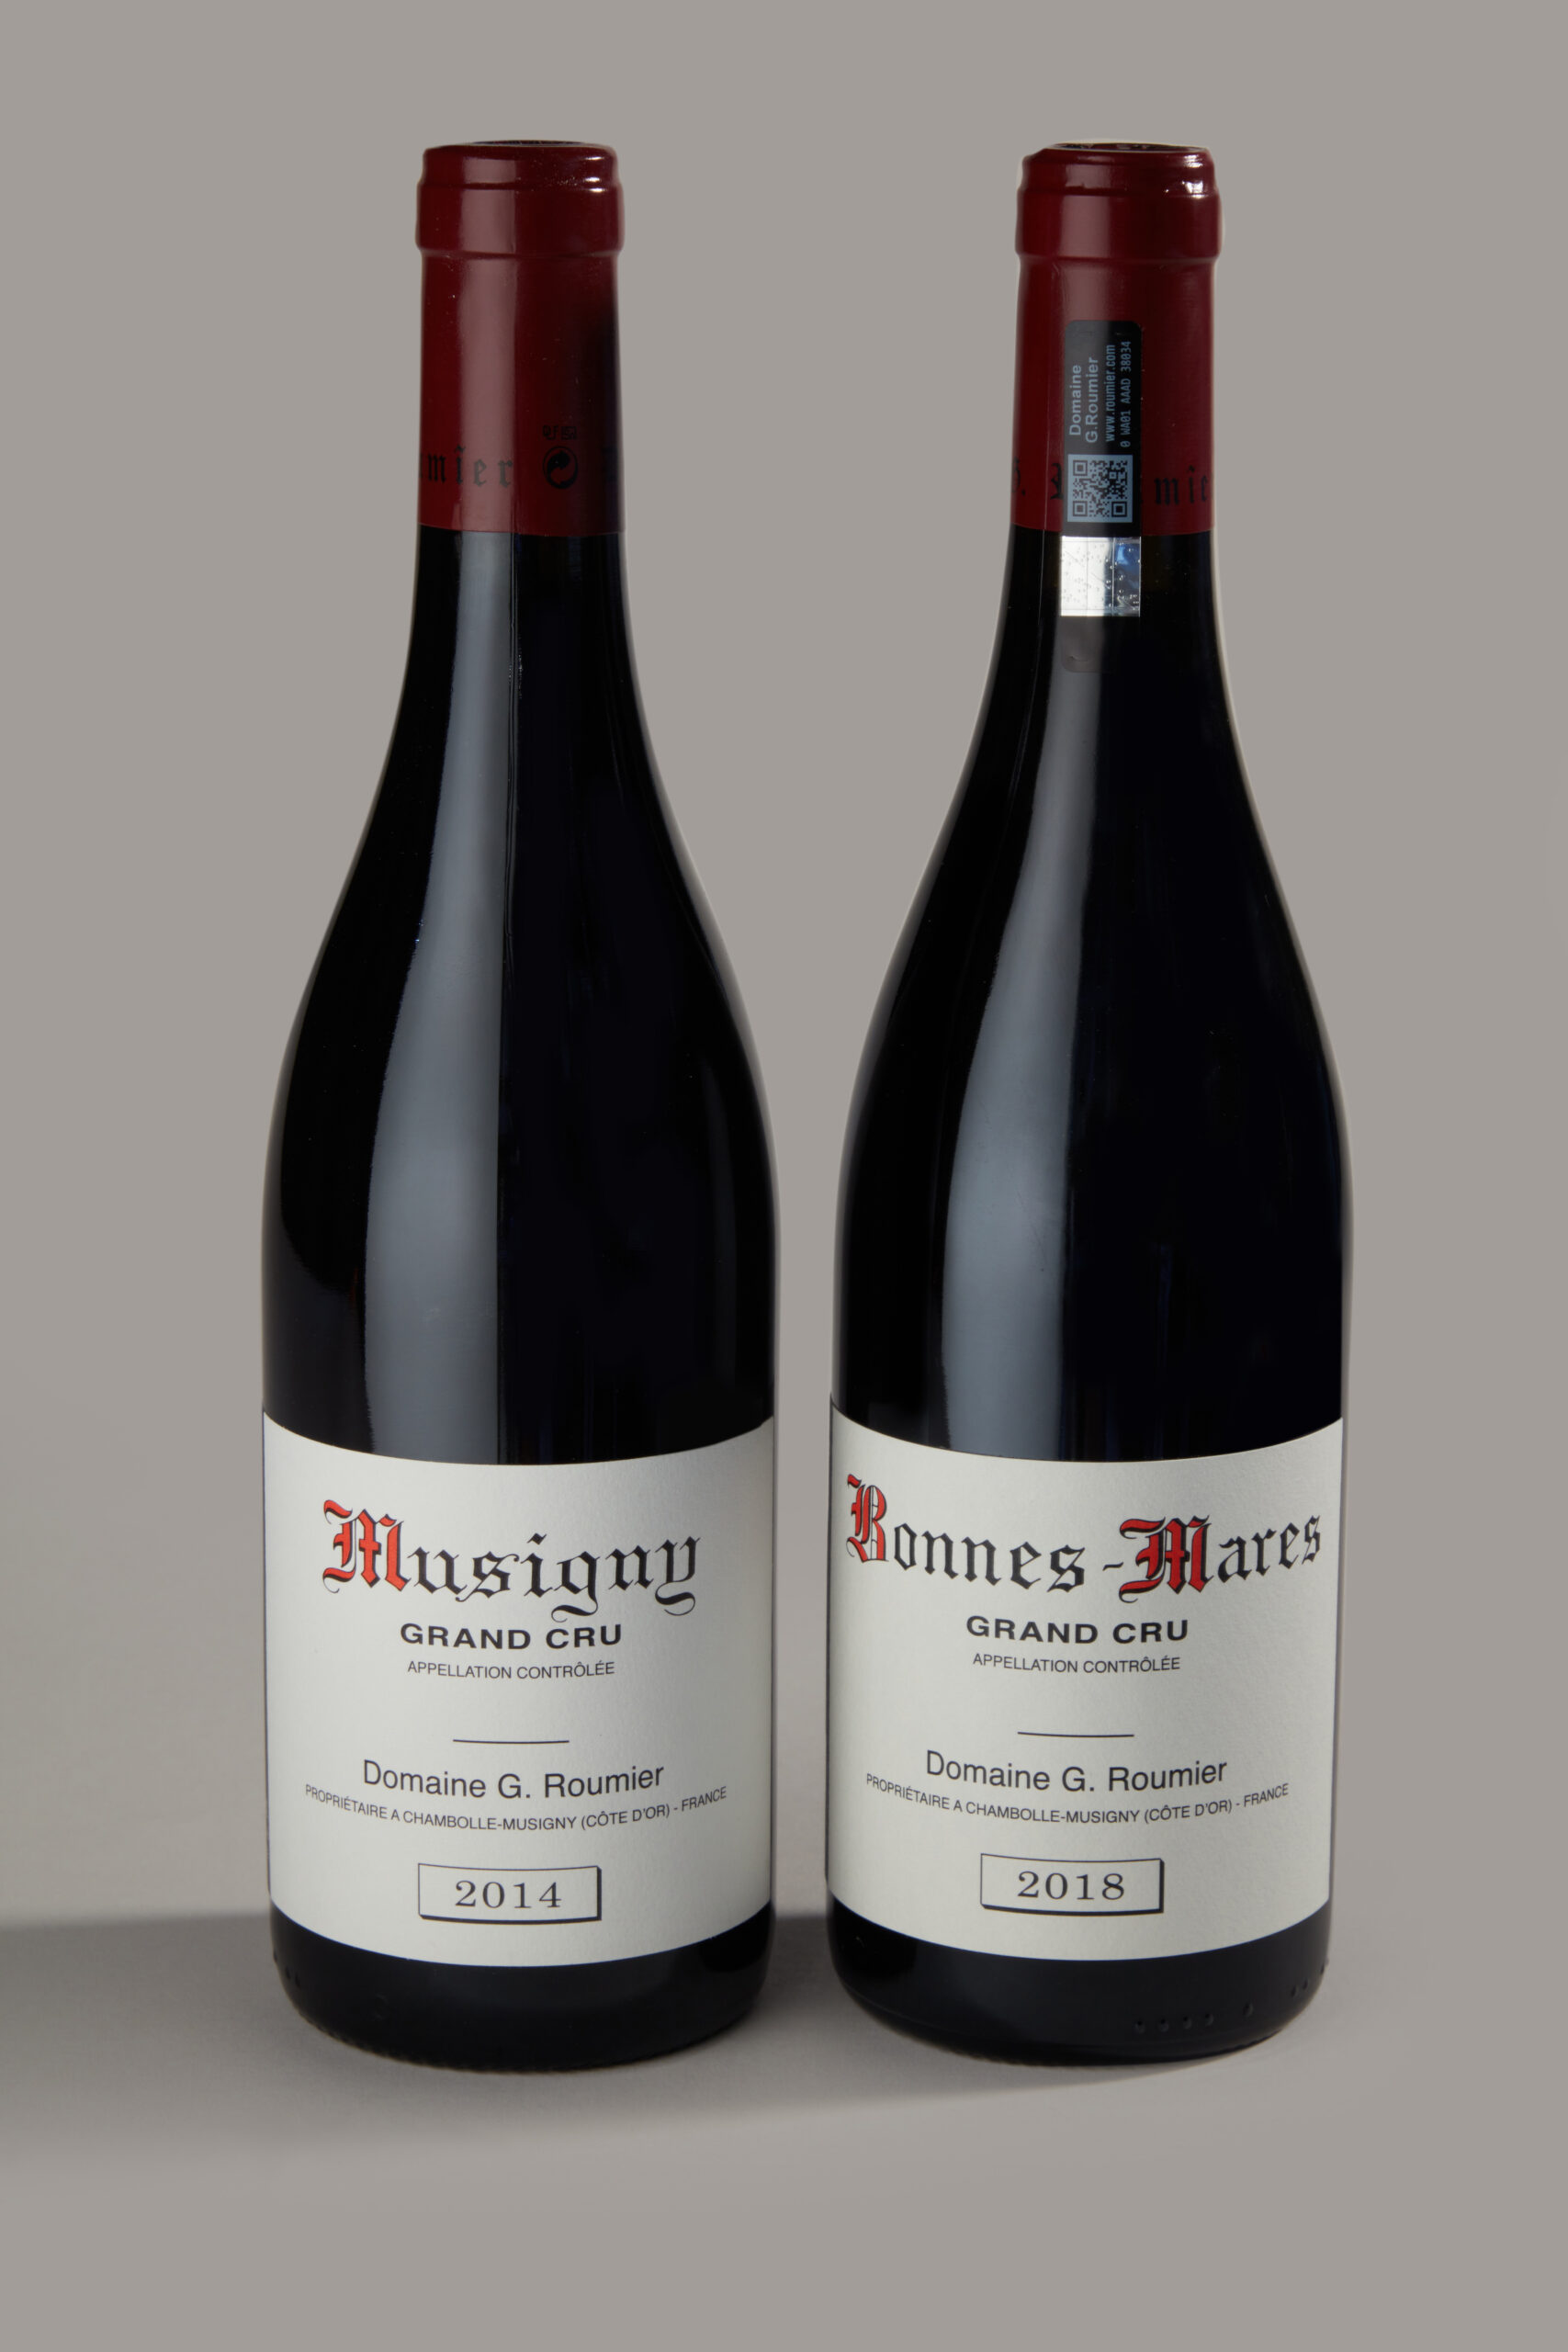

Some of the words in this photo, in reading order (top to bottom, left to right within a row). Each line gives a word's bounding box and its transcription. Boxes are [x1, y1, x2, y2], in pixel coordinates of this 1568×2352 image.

[1120, 341, 1132, 373] 38034
[1068, 364, 1082, 436] Domaine
[1085, 356, 1099, 443] G.Roumier
[1104, 345, 1116, 442] www.roumier.com
[1120, 379, 1132, 404] AAAD
[1120, 410, 1132, 435] WA01
[419, 444, 514, 488] mier
[321, 1499, 701, 1623] Musigny
[400, 1623, 531, 1650] GRAND
[546, 1623, 622, 1650] CRU
[966, 1615, 1099, 1645] GRAND
[1112, 1619, 1189, 1645] CRU
[407, 1660, 512, 1679] APPELLATION
[516, 1659, 615, 1679] CONTRÔLÉE
[973, 1653, 1077, 1674] APPELLATION
[1082, 1653, 1181, 1674] CONTRÔLÉE
[364, 1758, 487, 1798] Domaine
[497, 1773, 531, 1799] G.
[544, 1765, 665, 1799] Roumier
[926, 1749, 1051, 1792] Domaine
[1061, 1766, 1095, 1792] G.
[1108, 1759, 1228, 1792] Roumier
[305, 1783, 389, 1819] PROPRIÉTAIRE
[390, 1808, 400, 1822] A
[402, 1810, 577, 1831] CHAMBOLLE-MUSIGNY
[581, 1810, 628, 1831] (CÔTE
[631, 1804, 670, 1822] D'OR)
[681, 1785, 728, 1812] FRANCE
[866, 1772, 950, 1810] PROPRIÉTAIRE
[953, 1799, 964, 1813] A
[965, 1801, 1140, 1824] CHAMBOLLE-MUSIGNY
[1144, 1804, 1191, 1825] (CÔTE
[1194, 1798, 1233, 1818] D'OR)
[1243, 1782, 1290, 1808] FRANCE
[454, 1880, 563, 1909] 2014
[1017, 1871, 1126, 1902] 2018
